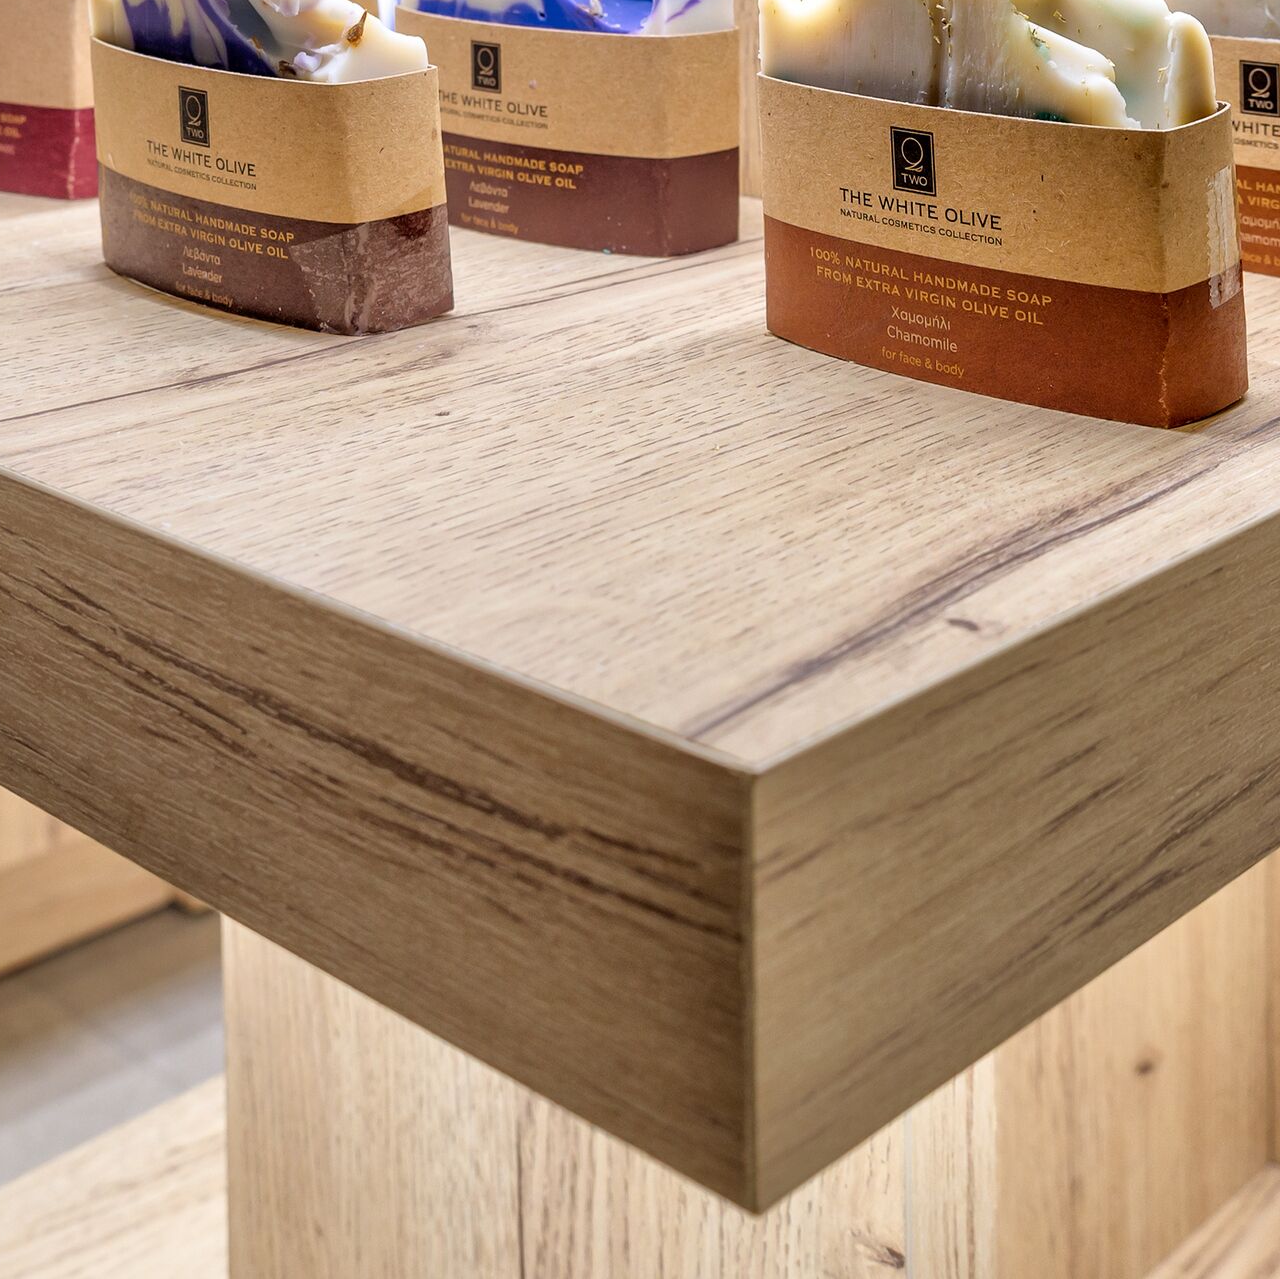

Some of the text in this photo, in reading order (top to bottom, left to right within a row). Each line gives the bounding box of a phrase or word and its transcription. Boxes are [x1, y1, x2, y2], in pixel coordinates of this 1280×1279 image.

[477, 75, 496, 87] TWO
[461, 95, 503, 112] WHITE
[506, 102, 548, 118] OLIVE
[1248, 98, 1274, 110] TWO
[185, 126, 205, 139] TWO
[1233, 137, 1279, 150] OSMETICS
[147, 139, 257, 177] THE WHITE OLIVE
[443, 144, 584, 175] ATURAL HANDMADE SOAP
[174, 166, 211, 181] COSMETICS
[211, 175, 257, 191] COLLECTION
[445, 158, 577, 189] EXTRA VIRGIN OLIVE OIL
[901, 172, 928, 187] TWO
[468, 195, 509, 214] Lavender
[839, 187, 1002, 231] THE WHITE OLIVE
[150, 200, 193, 222] NATURAL
[195, 214, 257, 237] HANDMADE
[260, 227, 295, 243] SOAP
[839, 208, 1003, 246] NATURAL COSMETICS COLLECTION
[157, 218, 188, 237] EXTRA
[190, 227, 226, 247] VIRGIN
[229, 238, 263, 255] OLIVE
[266, 245, 289, 260] OIL
[182, 263, 223, 284] Lavender
[810, 246, 1052, 307] 100% NATURAL HANDMADE SOAP
[212, 291, 234, 307] body
[816, 265, 1044, 326] FROM EXTRA VIRGIN OLIVE OIL
[891, 305, 950, 331] Χαμομήλι
[886, 325, 958, 353] Chamomile
[881, 345, 965, 380] for face & body
